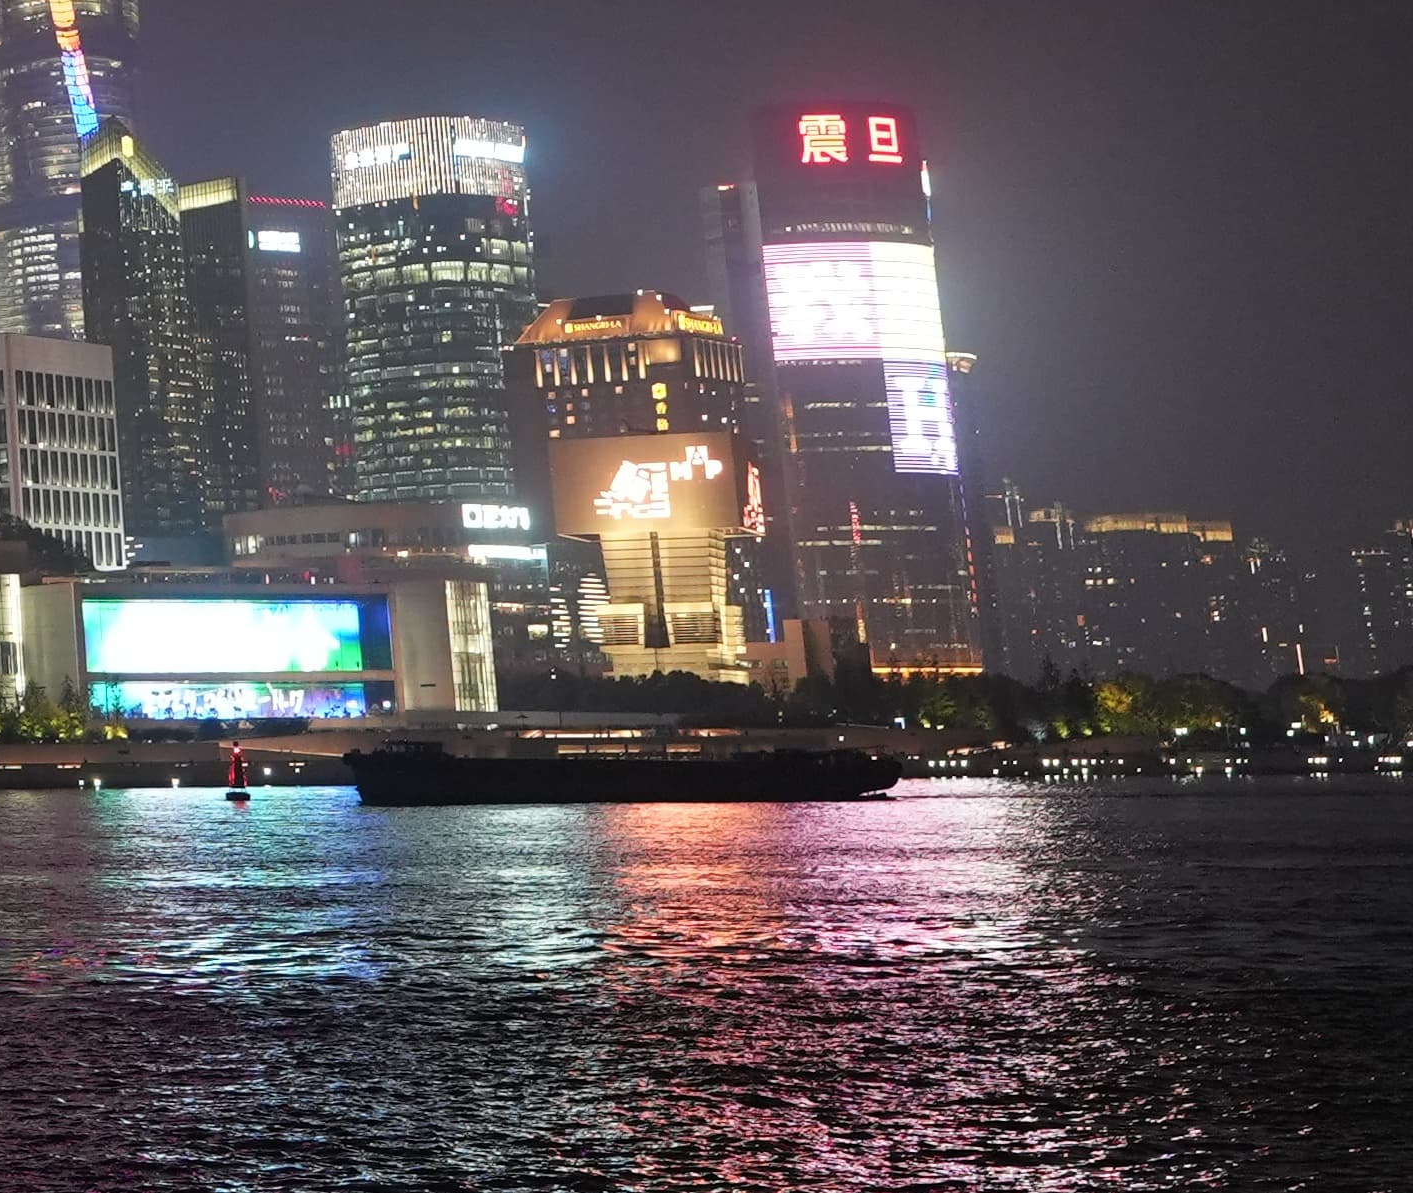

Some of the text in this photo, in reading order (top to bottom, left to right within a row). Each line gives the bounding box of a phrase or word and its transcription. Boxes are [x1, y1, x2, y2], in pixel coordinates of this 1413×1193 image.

[799, 114, 903, 163] 震旦
[573, 319, 622, 332] SHANGRI-LA
[684, 317, 724, 335] SHANGRI-LA
